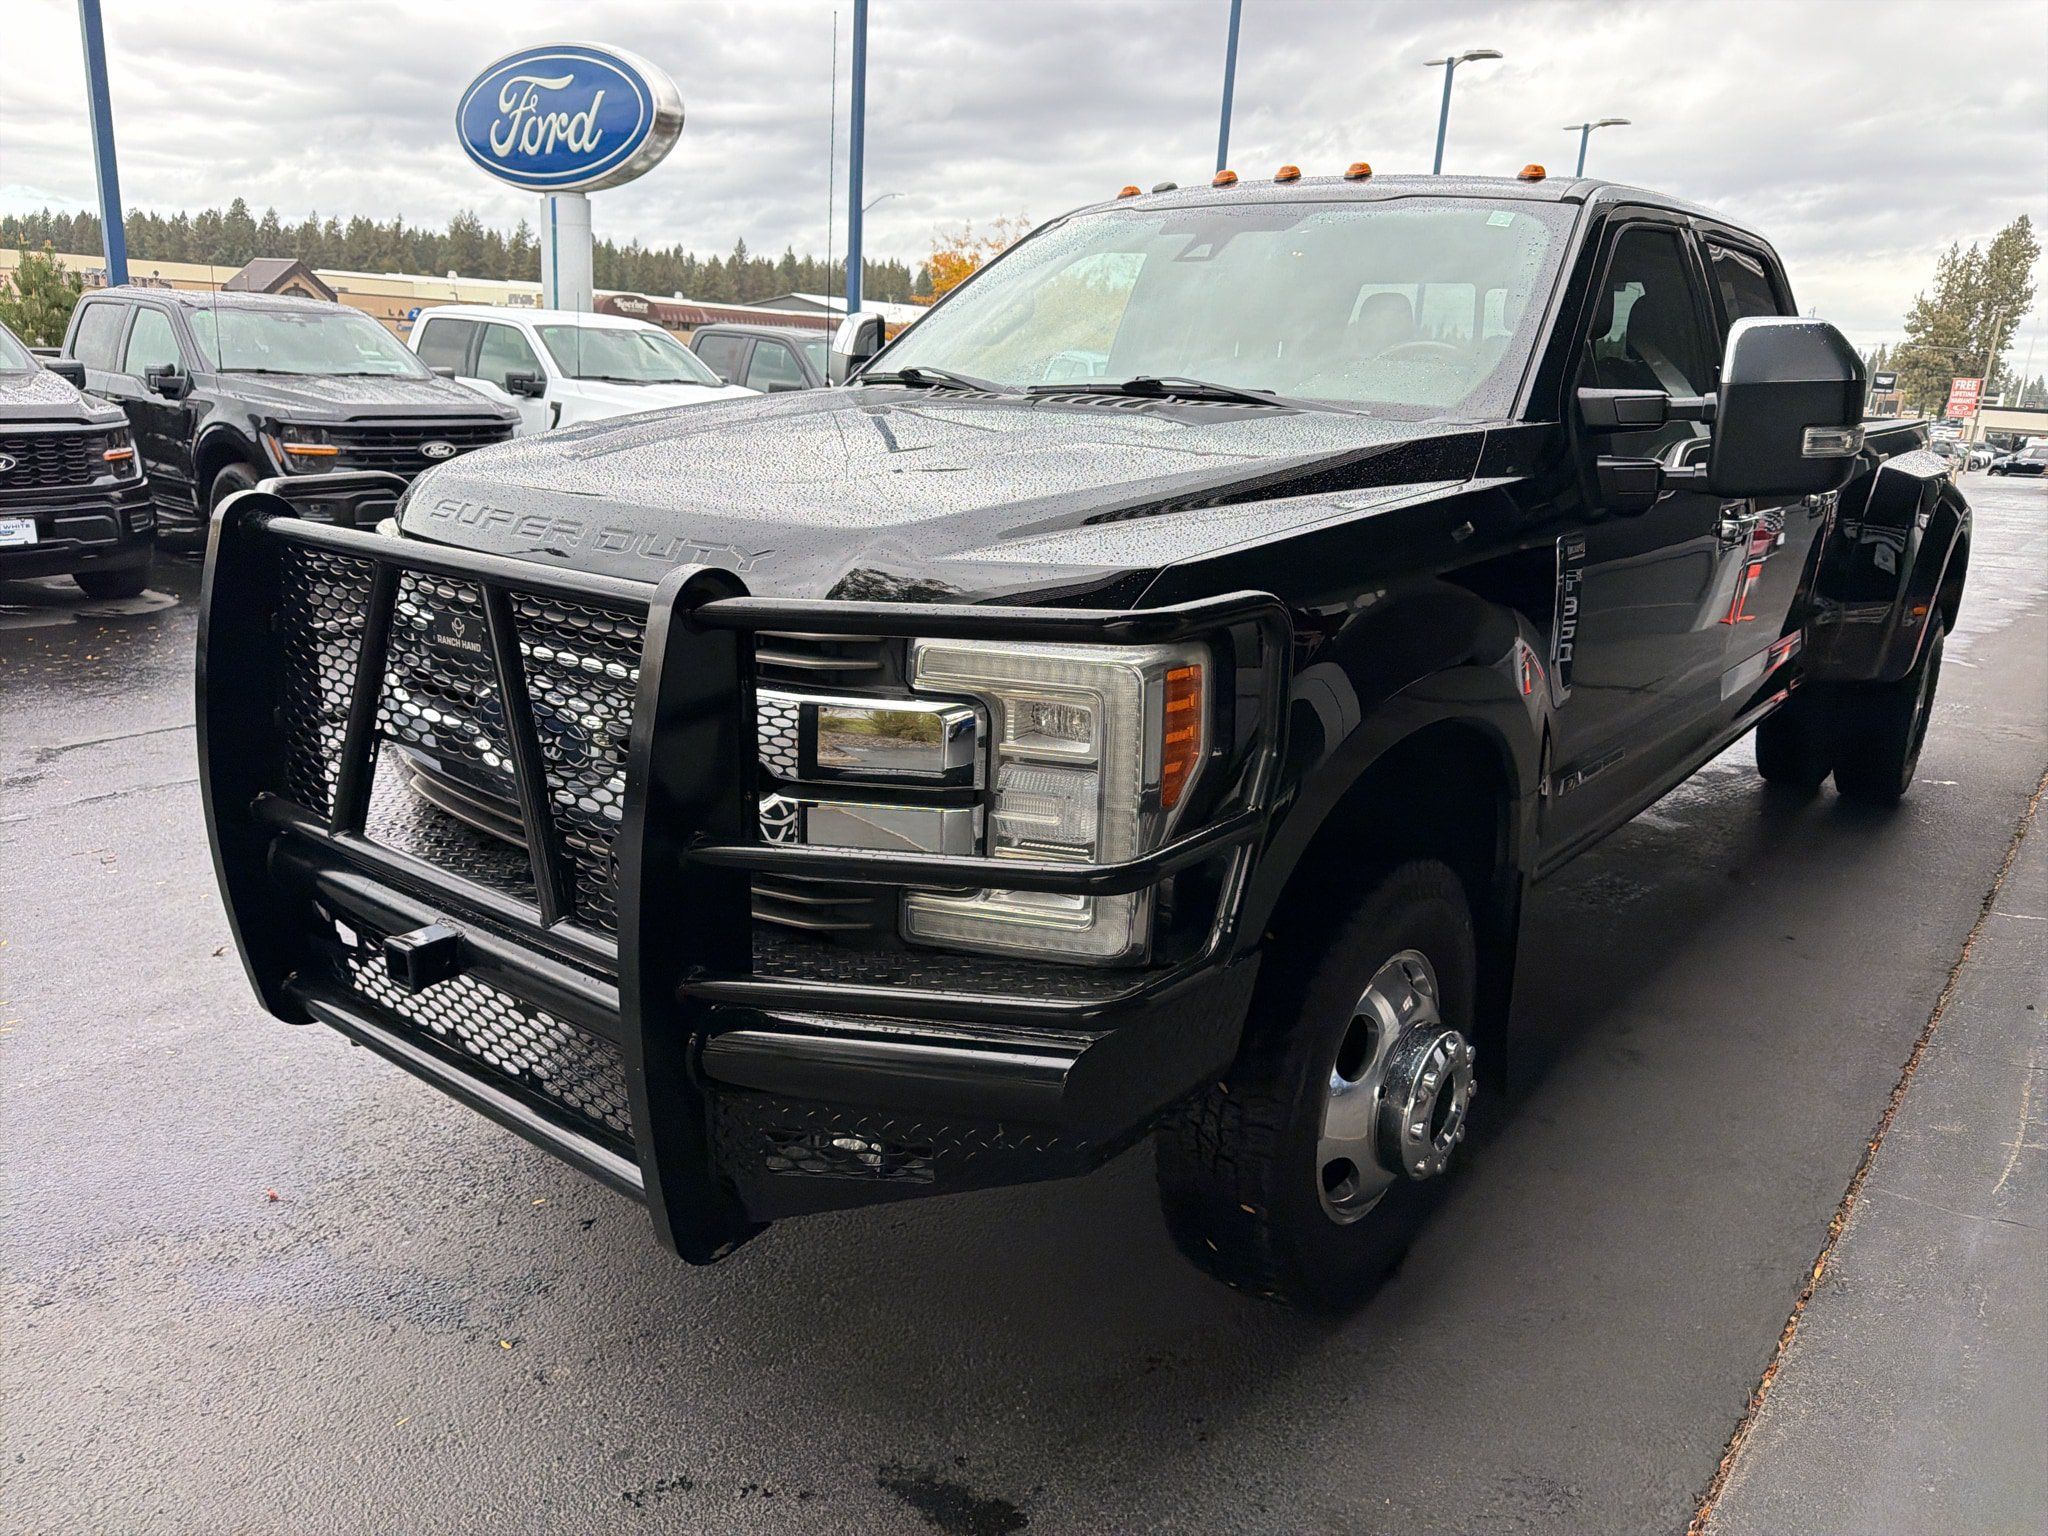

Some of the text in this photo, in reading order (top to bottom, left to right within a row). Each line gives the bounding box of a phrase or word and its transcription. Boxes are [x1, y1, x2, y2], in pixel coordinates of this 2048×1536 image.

[490, 73, 606, 158] Ford
[1955, 379, 1978, 391] FREE
[430, 500, 777, 573] SUPER DUTY
[437, 634, 481, 652] RANCH HAND
